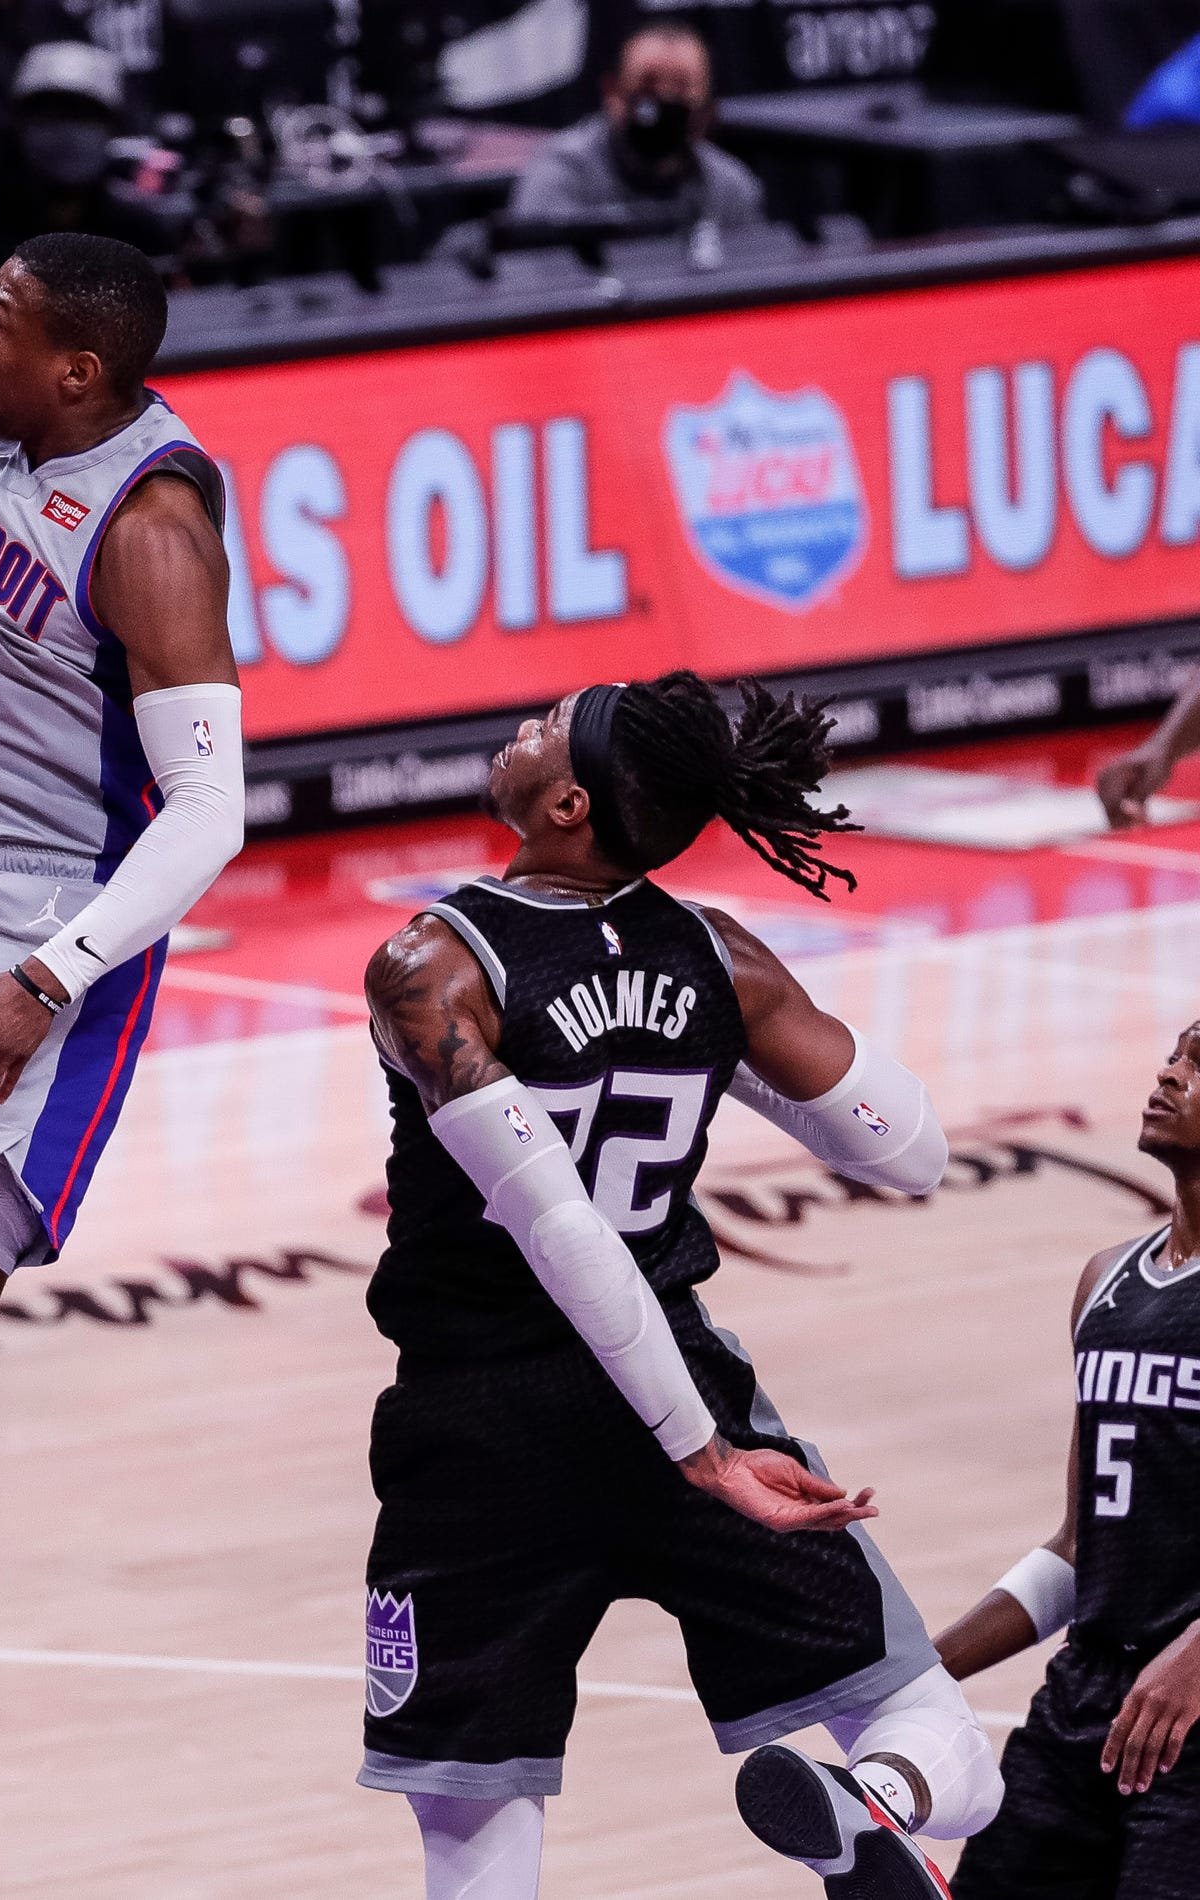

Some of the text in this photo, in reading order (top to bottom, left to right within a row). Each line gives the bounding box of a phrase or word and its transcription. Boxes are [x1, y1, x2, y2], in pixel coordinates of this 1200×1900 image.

[50, 494, 86, 520] Flagstar
[388, 418, 629, 646] OIL
[546, 969, 697, 1053] HOLMES
[1095, 1423, 1136, 1518] 5
